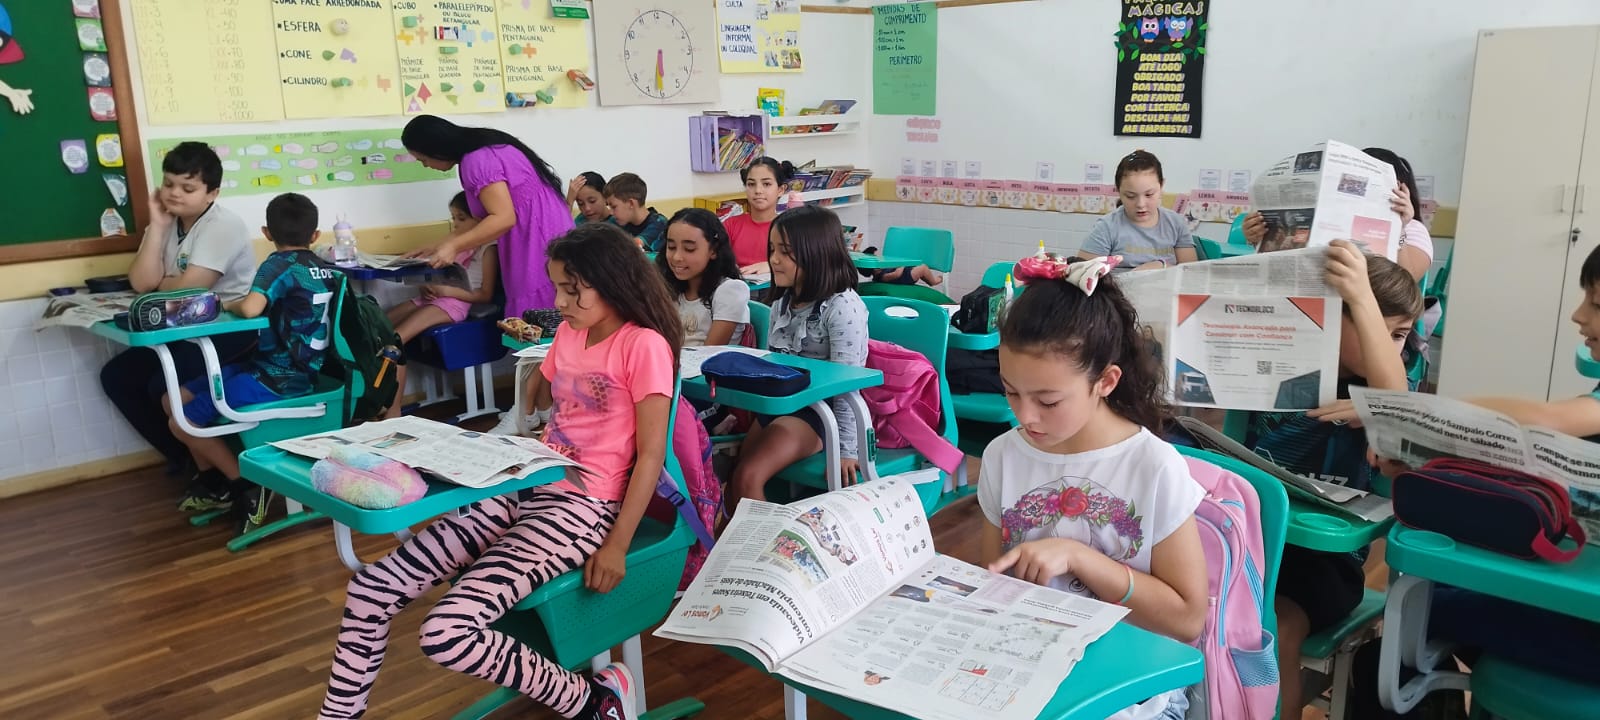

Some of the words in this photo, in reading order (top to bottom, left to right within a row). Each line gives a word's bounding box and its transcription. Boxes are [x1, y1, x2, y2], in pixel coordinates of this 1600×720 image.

[397, 2, 416, 10] CUBO
[725, 0, 743, 8] CULTA
[878, 4, 905, 14] MEDIDAS
[911, 4, 920, 12] DE
[884, 13, 926, 25] COMPRIMENTO
[283, 20, 321, 32] ESFERA
[501, 24, 525, 34] PRISMA
[721, 24, 751, 32] LINGUAGEM
[726, 33, 752, 42] INFORMAL
[286, 50, 312, 59] CONE
[1140, 53, 1161, 62] BOM
[1163, 53, 1184, 62] DIA!
[506, 65, 530, 74] PRISMA
[287, 77, 327, 86] CILINDRO
[507, 75, 545, 83] HEXAGONAL
[1134, 72, 1185, 82] OBRIGADO!
[675, 79, 680, 88] 5
[1132, 82, 1151, 91] BOA
[1152, 82, 1185, 92] TARDE!
[1131, 93, 1150, 102] POR
[1150, 93, 1184, 102] FAVOR!
[1124, 103, 1146, 112] COM
[1122, 124, 1137, 134] ME
[1236, 305, 1275, 314] TECNOBLOCO
[1410, 417, 1443, 435] Nacional
[1444, 431, 1469, 442] neste
[1470, 436, 1505, 450] sábado
[1446, 420, 1484, 436] Sampaio
[1485, 430, 1518, 443] Correa
[1533, 443, 1569, 462] Compac
[1569, 458, 1583, 467] se
[1536, 454, 1562, 468] evitar
[720, 577, 735, 585] Assis
[746, 579, 778, 593] Machado
[712, 588, 729, 596] Soares
[728, 589, 757, 600] Teixeira
[756, 593, 770, 602] em
[692, 610, 710, 619] Vamos
[776, 590, 813, 639] contempla
[768, 597, 805, 644] Videoaula
